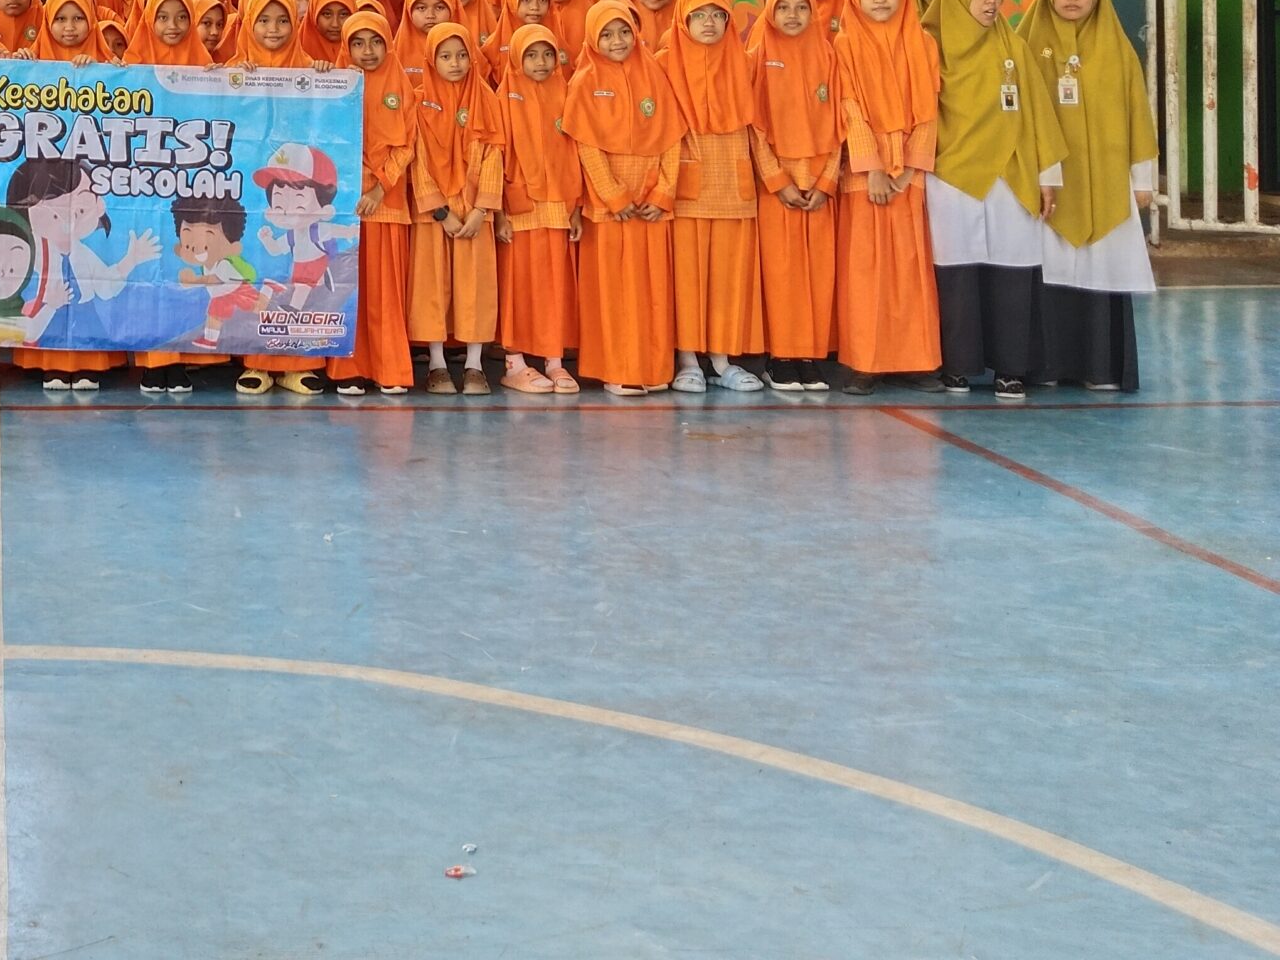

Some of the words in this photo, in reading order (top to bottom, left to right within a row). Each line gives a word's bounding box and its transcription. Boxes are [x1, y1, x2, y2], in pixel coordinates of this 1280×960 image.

[181, 74, 222, 84] Kemenkes
[90, 164, 242, 200] SEKOLAH
[260, 311, 345, 325] WONOGIRI
